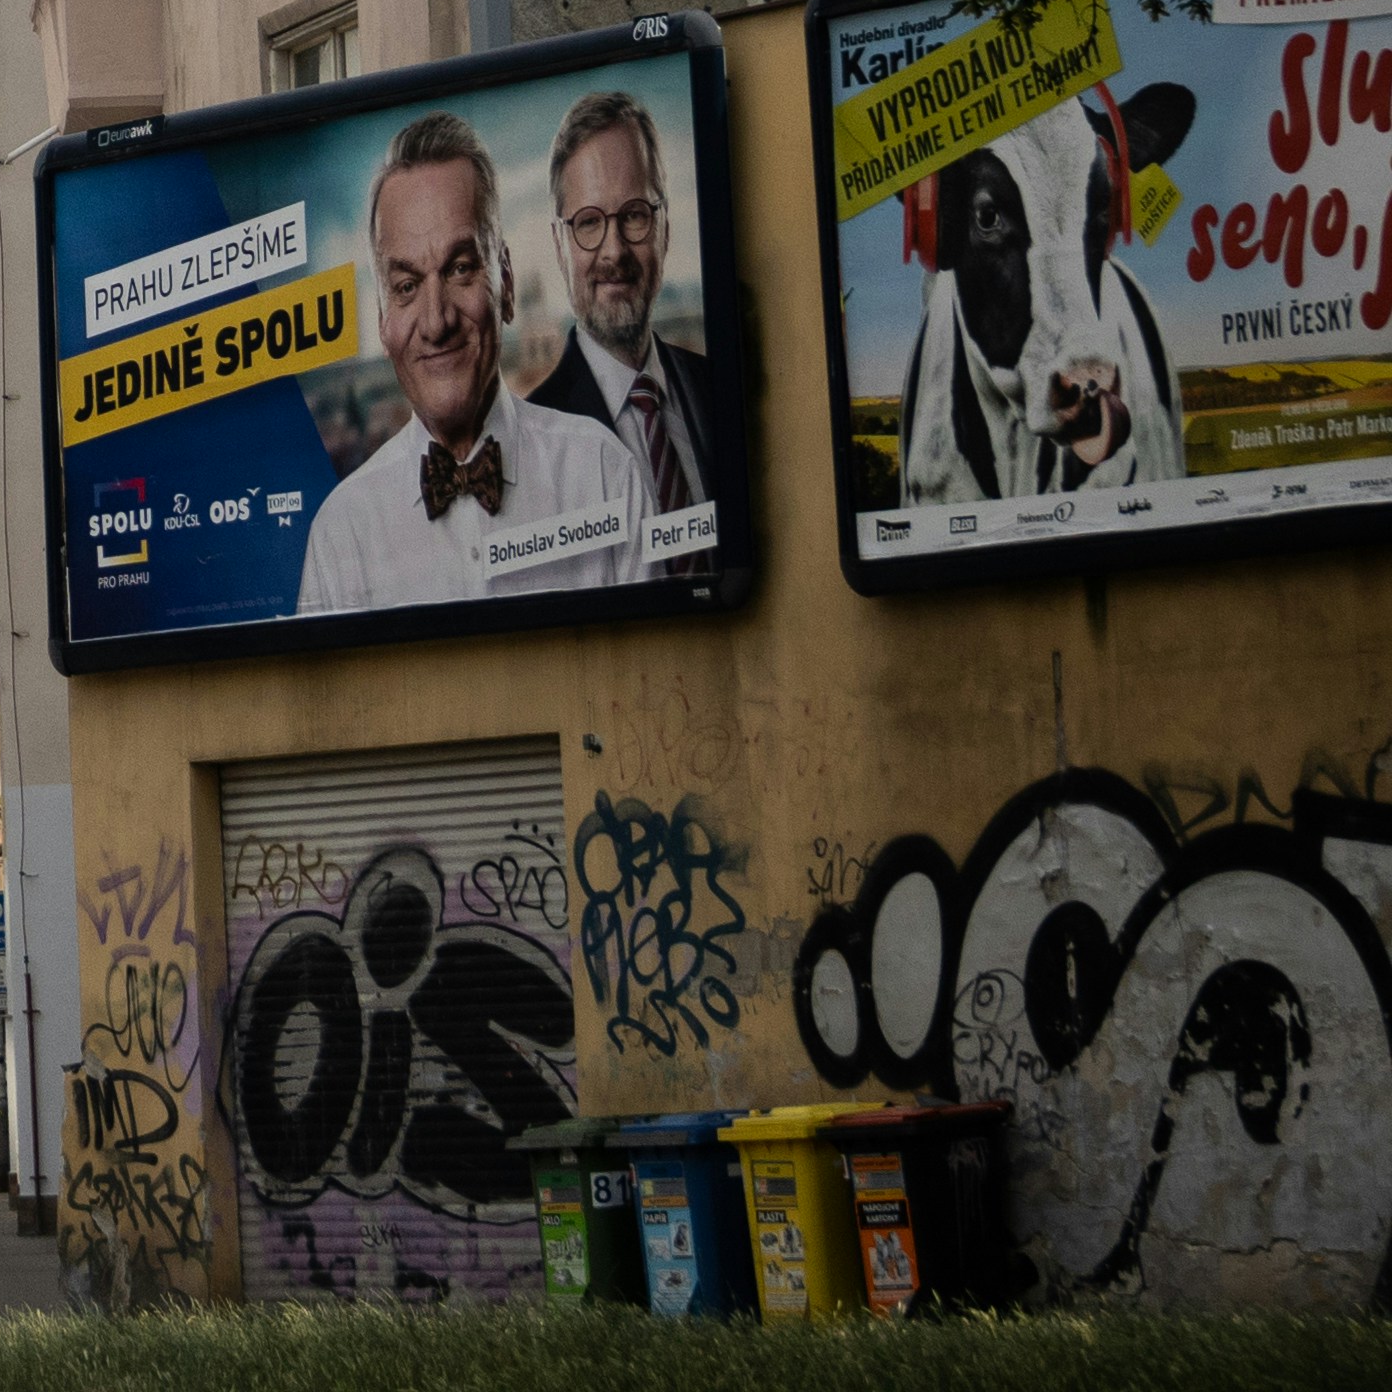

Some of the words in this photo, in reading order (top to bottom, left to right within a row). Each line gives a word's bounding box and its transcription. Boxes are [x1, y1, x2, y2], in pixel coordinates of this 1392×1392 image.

[633, 16, 668, 41] ORIS
[897, 15, 946, 37] divadlo
[841, 35, 945, 89] Karlí
[110, 119, 153, 142] euroawk
[841, 124, 946, 201] PŘIDÁVÁME
[948, 86, 1006, 144] LETNÍ
[94, 263, 174, 321] PRAHU
[180, 220, 298, 292] ZLEPŠÍME
[1222, 302, 1283, 344] PRVNÍ
[1290, 292, 1353, 336] ČESKÝ
[73, 323, 205, 423] JEDINĚ
[214, 289, 344, 377] SPOLU
[1275, 422, 1315, 445] Troška
[1327, 418, 1354, 439] Petr
[210, 497, 250, 524] ODS
[268, 498, 286, 509] TOP
[89, 508, 152, 537] SPOLU
[164, 513, 201, 531] KDU-ČSL
[880, 525, 911, 542] Prima
[489, 534, 554, 564] Bohuslav
[558, 514, 620, 546] Svoboda
[651, 526, 684, 549] Petr
[98, 576, 116, 589] PRO
[118, 571, 150, 587] PRAHU
[543, 1215, 560, 1225] SKLO
[758, 1213, 784, 1222] PLASTY
